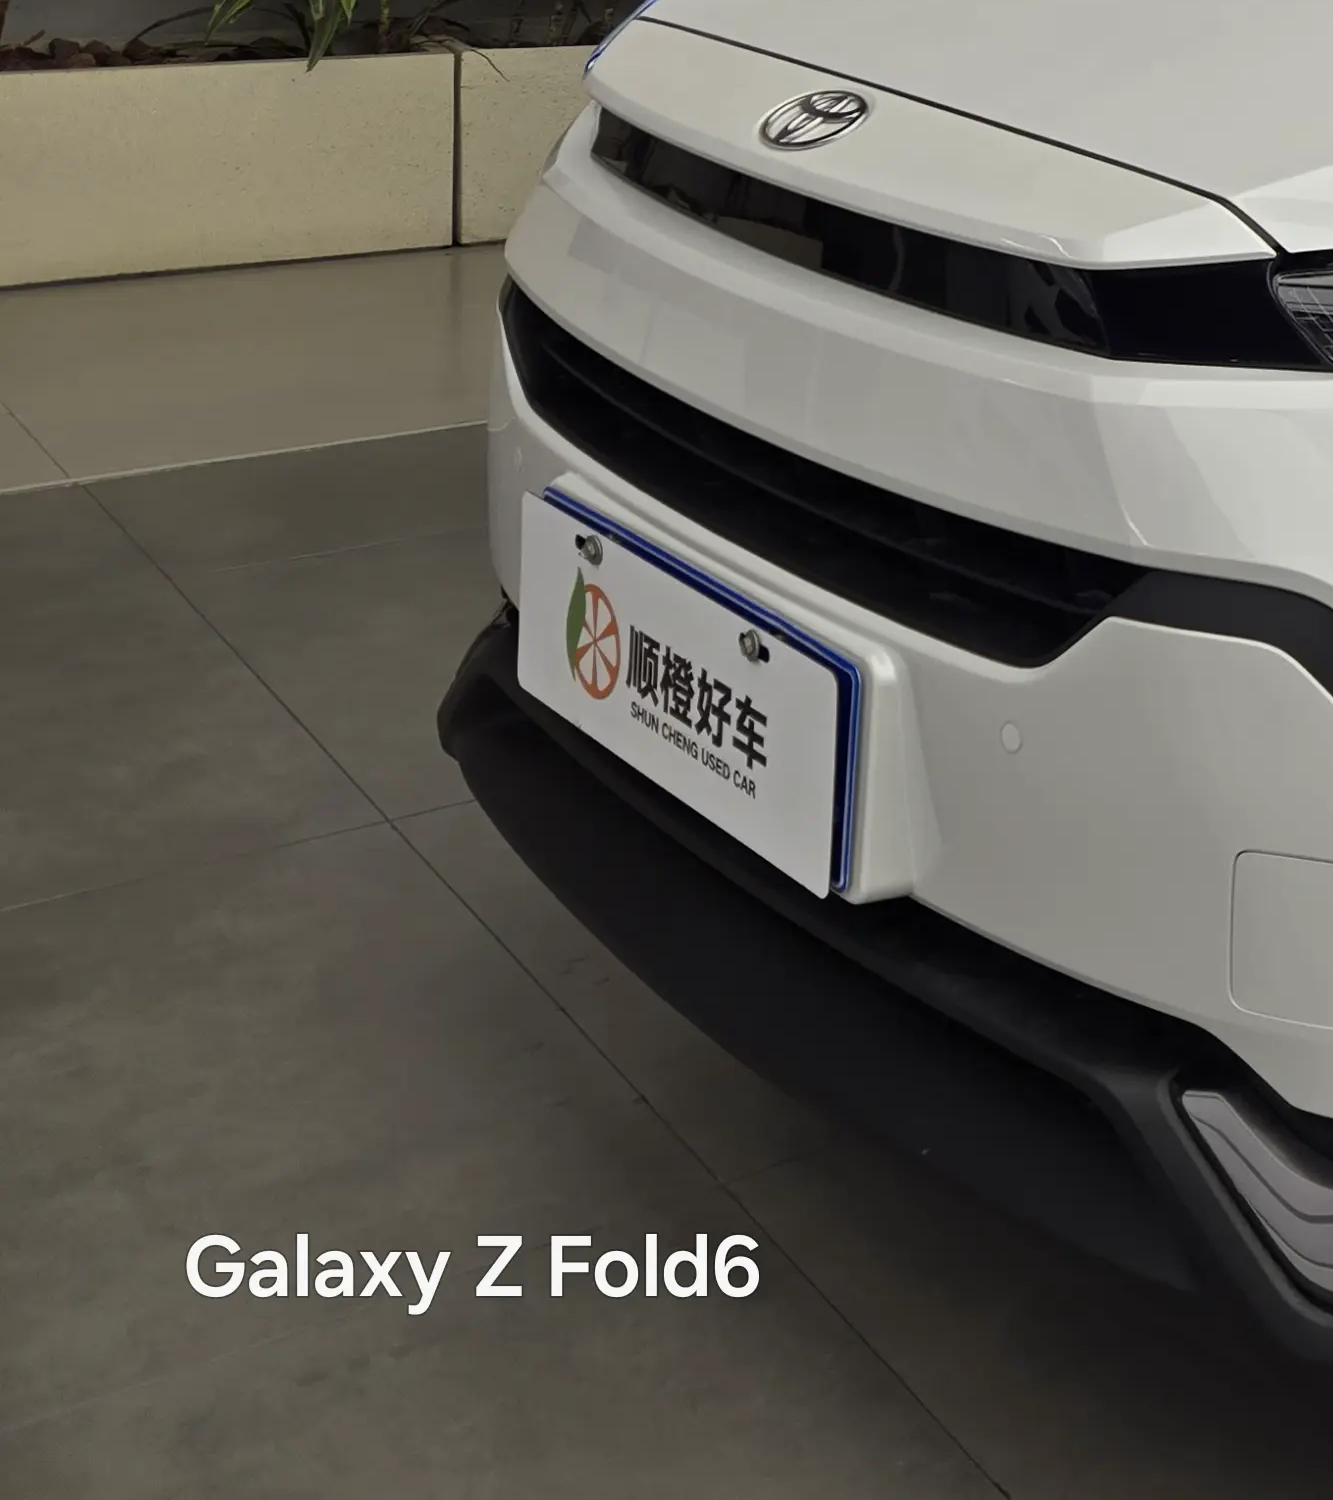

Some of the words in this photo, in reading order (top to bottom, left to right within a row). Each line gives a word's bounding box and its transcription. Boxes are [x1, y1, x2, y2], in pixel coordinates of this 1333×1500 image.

[625, 624, 768, 770] 顺橙好车
[630, 701, 660, 735] SHUN
[661, 722, 699, 761] CHENG
[701, 747, 731, 781] USED
[732, 770, 757, 800] CAR
